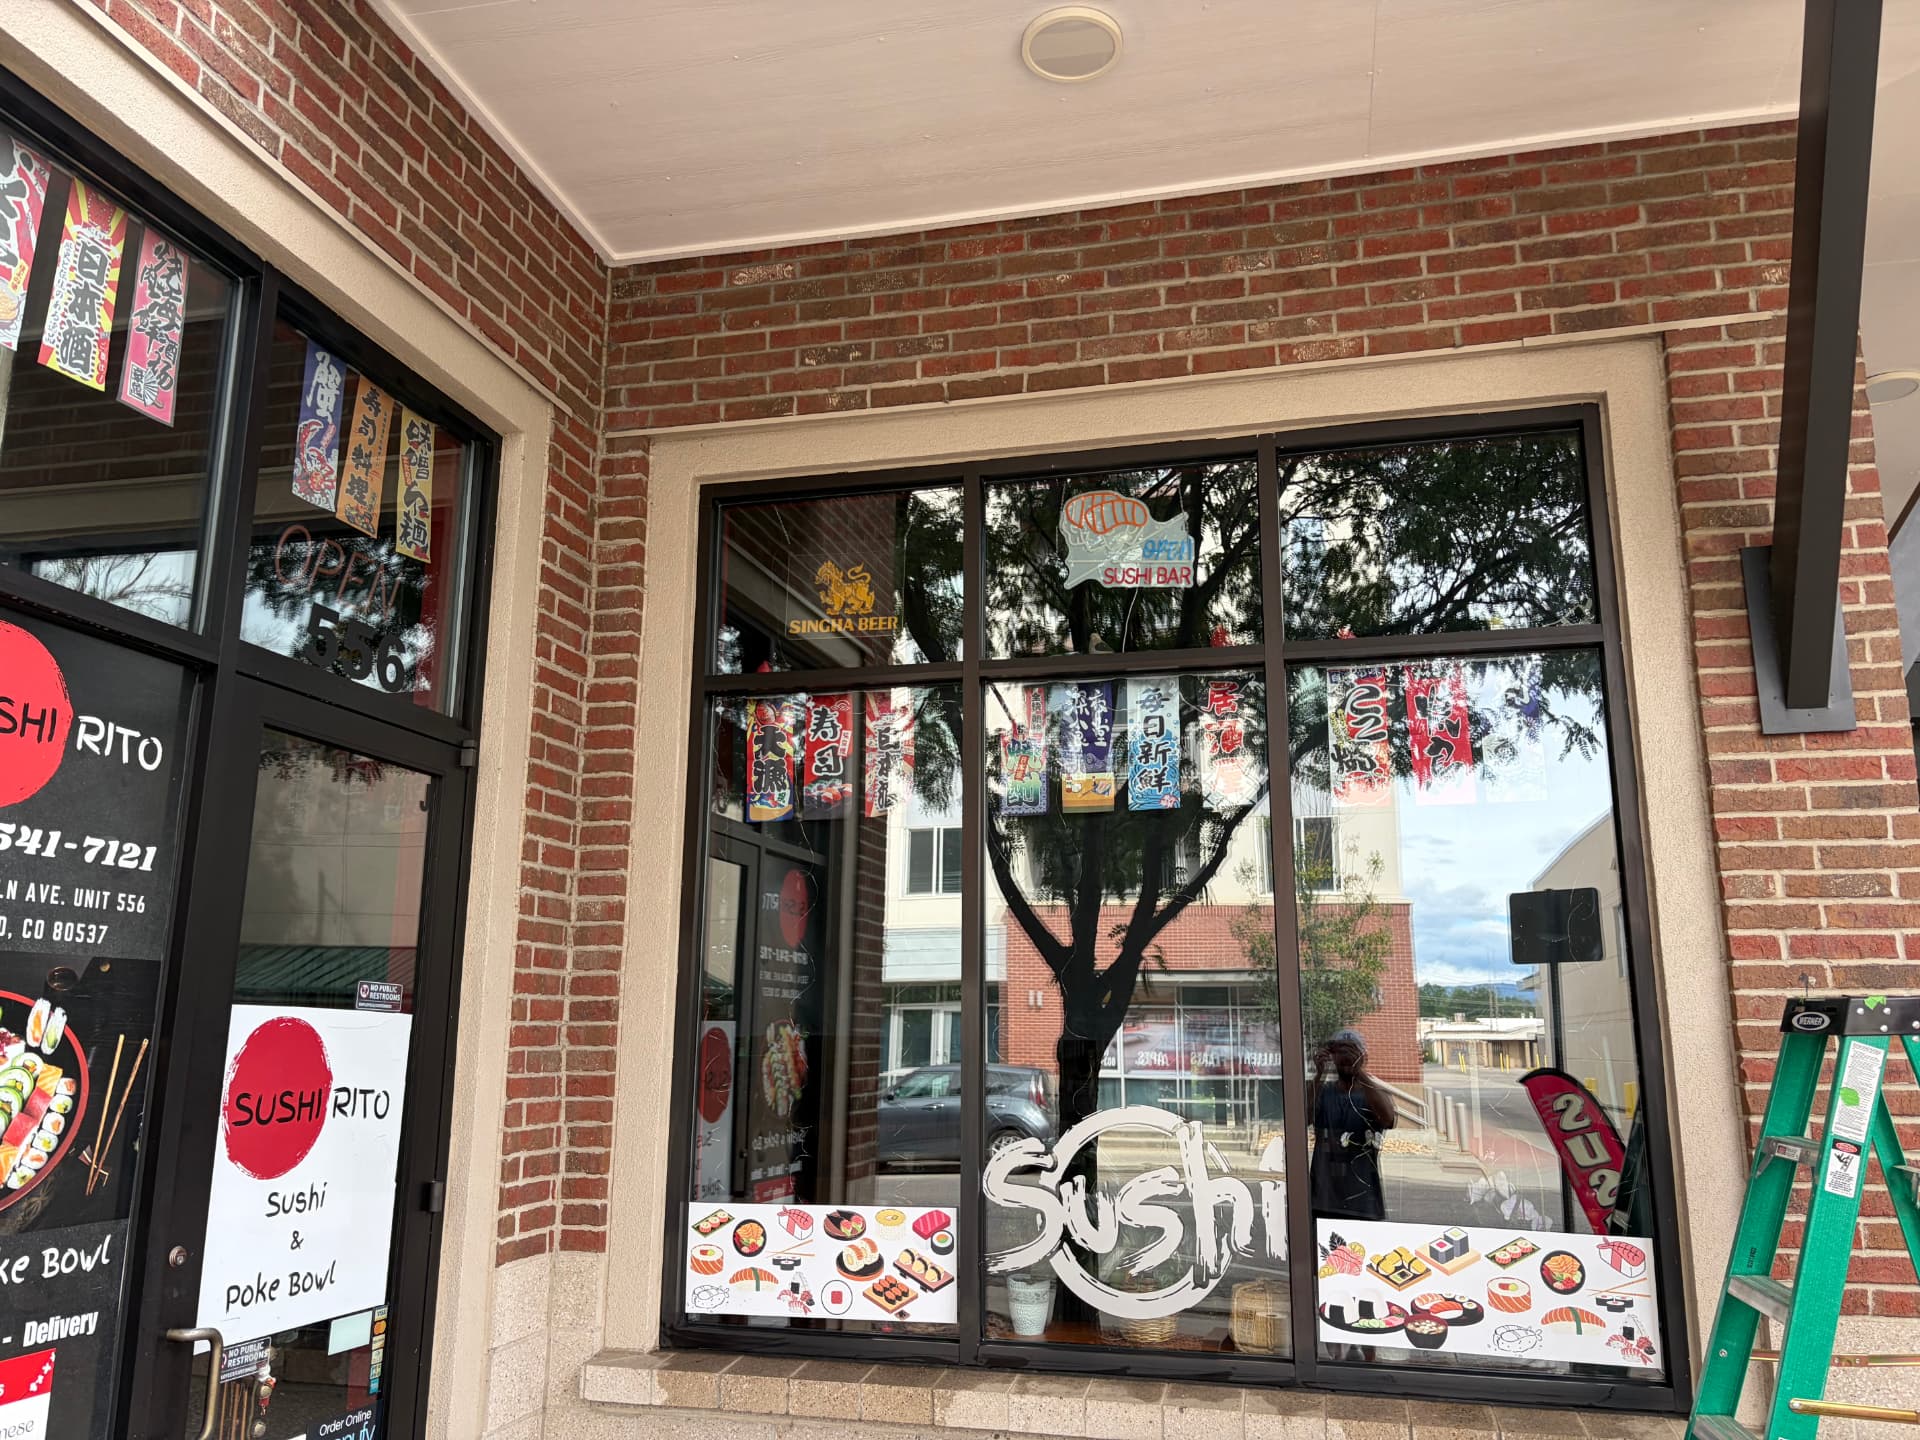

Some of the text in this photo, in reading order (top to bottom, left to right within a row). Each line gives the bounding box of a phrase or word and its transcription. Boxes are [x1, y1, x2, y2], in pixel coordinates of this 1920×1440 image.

[60, 240, 109, 375] 日本酒
[1142, 538, 1193, 561] OPEN
[1102, 566, 1192, 585] SUSHI BAR
[788, 616, 899, 634] SINGHA BEER
[303, 602, 406, 692] 556
[76, 715, 163, 771] RITO
[808, 706, 843, 776] 寿司
[1135, 688, 1172, 793] 毎日新鮮
[752, 725, 788, 793] 大漁
[25, 882, 65, 906] AVE.
[73, 887, 111, 910] UNIT
[116, 893, 146, 914] 556
[22, 918, 45, 940] CO
[52, 921, 109, 944] 80537
[369, 992, 401, 1001] RESTROOMS
[370, 983, 398, 993] NO PUBLIC
[231, 1086, 390, 1127] SUSHI RITO
[265, 1181, 328, 1217] Sushi
[981, 1119, 1288, 1280] Sushi
[41, 1234, 112, 1279] Bowl
[290, 1230, 304, 1250] &
[226, 1260, 337, 1314] Poke Bowl
[23, 1311, 99, 1348] Delivery
[227, 1349, 268, 1369] RESTROOMS
[228, 1341, 265, 1359] NO PUBLIC
[319, 1420, 345, 1437] Order
[345, 1409, 372, 1427] Online
